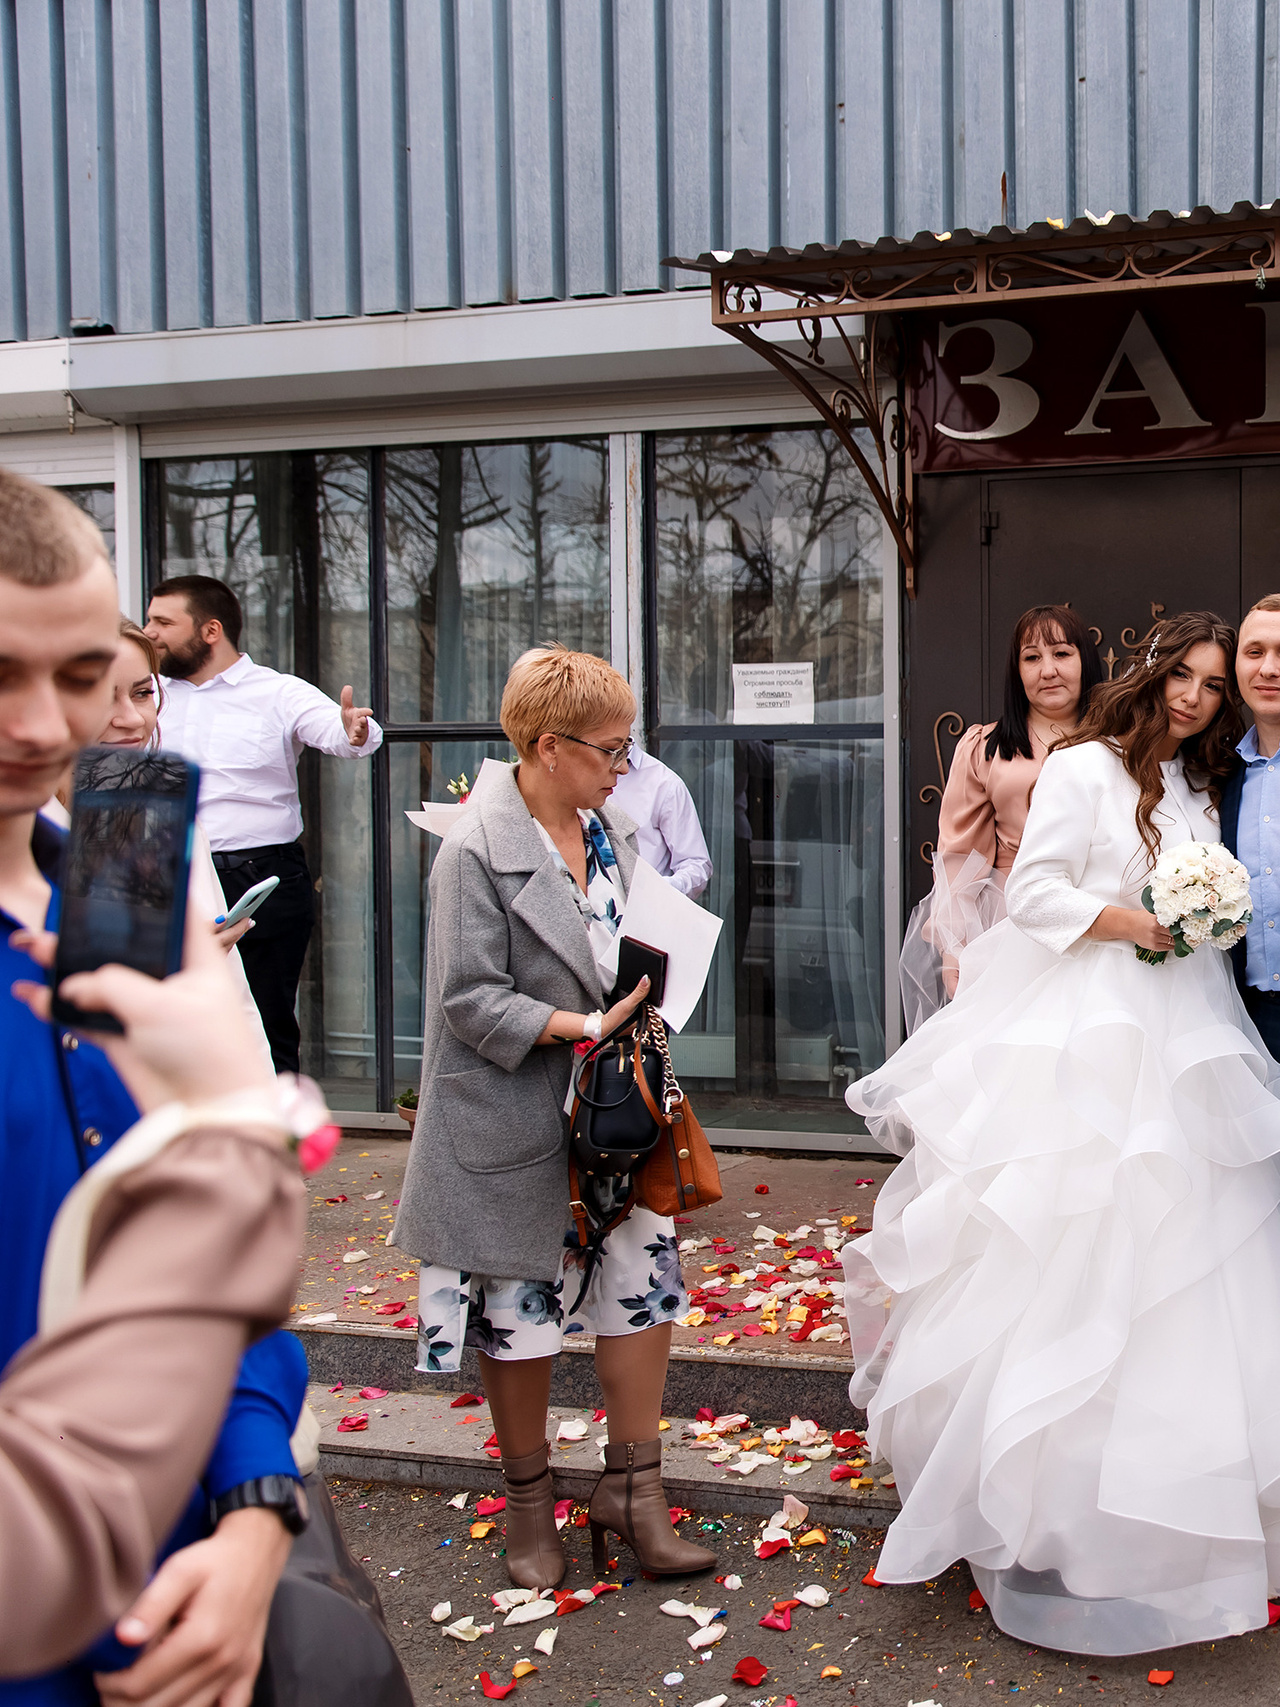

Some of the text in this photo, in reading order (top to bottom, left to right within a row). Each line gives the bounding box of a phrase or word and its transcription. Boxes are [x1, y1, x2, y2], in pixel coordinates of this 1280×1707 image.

[776, 668, 809, 676] граждане!
[776, 679, 803, 687] просьба
[754, 690, 793, 698] соблюдать
[756, 700, 791, 708] чистоту!!!
